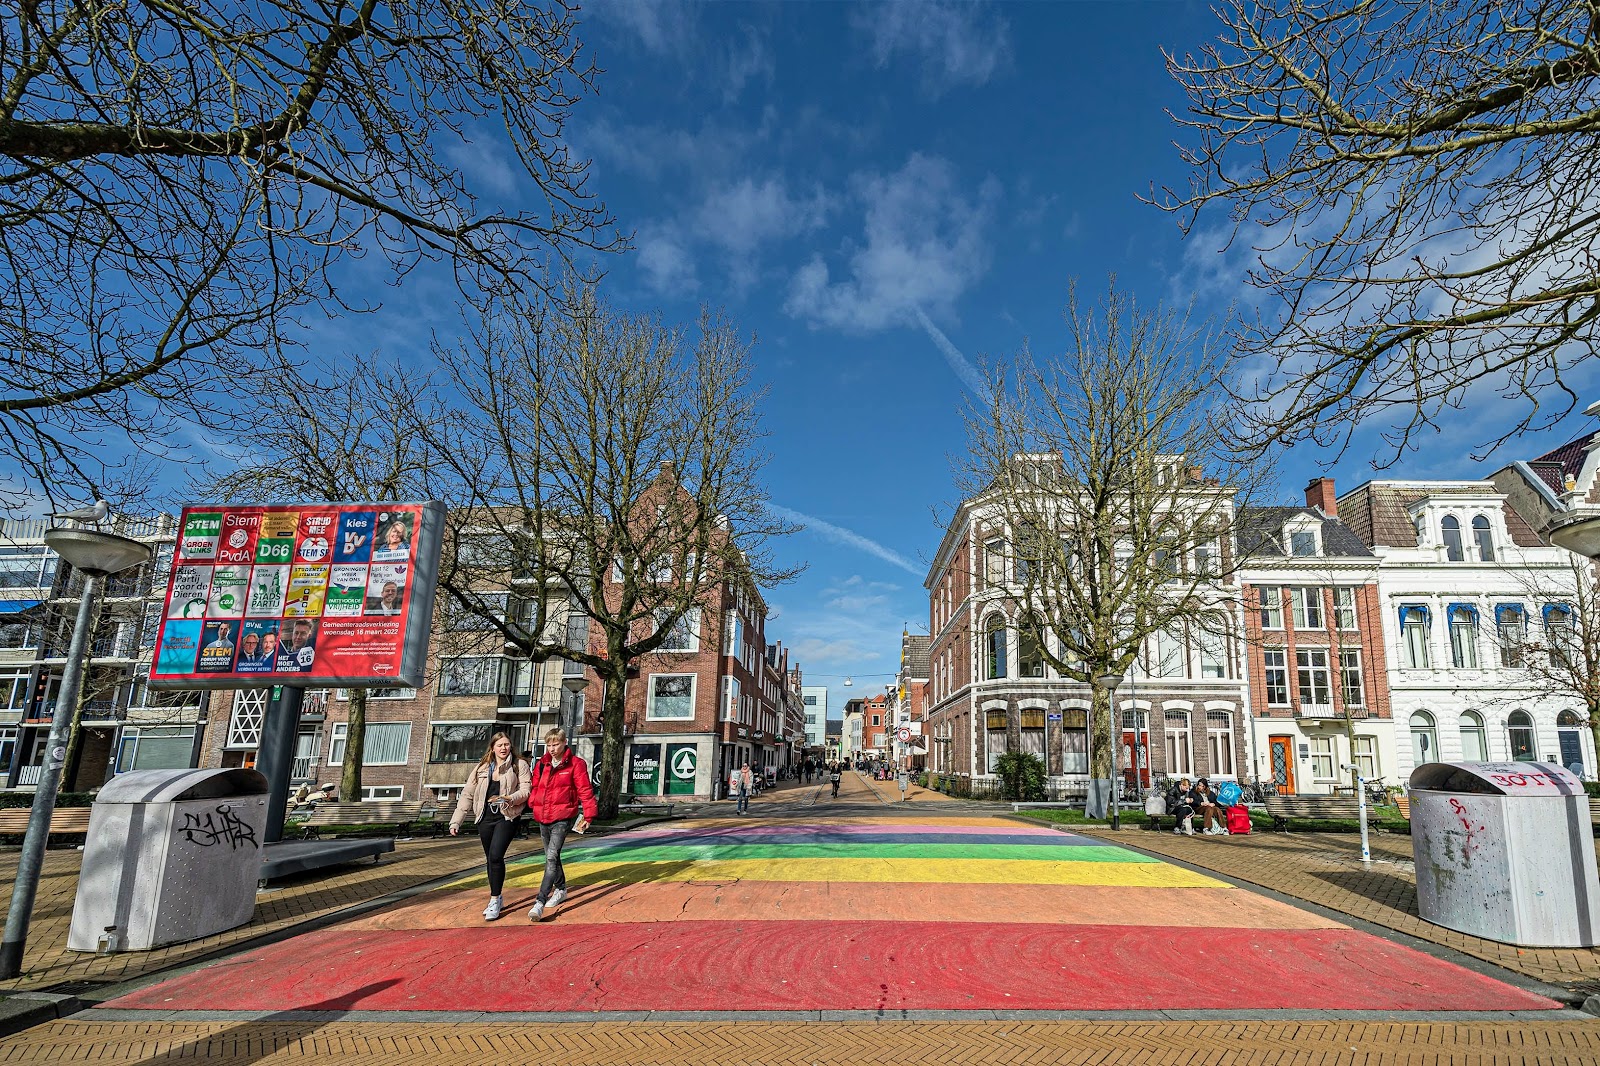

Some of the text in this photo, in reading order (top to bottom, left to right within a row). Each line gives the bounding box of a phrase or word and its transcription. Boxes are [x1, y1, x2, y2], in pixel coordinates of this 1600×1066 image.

[226, 514, 258, 526] Stem
[346, 519, 368, 528] kies
[187, 520, 220, 530] STEM
[308, 525, 326, 535] MEE
[260, 544, 290, 557] D66
[297, 548, 318, 557] STEM
[219, 550, 251, 562] PvdA
[177, 567, 197, 575] Kies
[176, 575, 200, 584] Partij
[251, 600, 280, 608] PARTIJ
[203, 648, 232, 656] STEM
[632, 771, 653, 780] klaar
